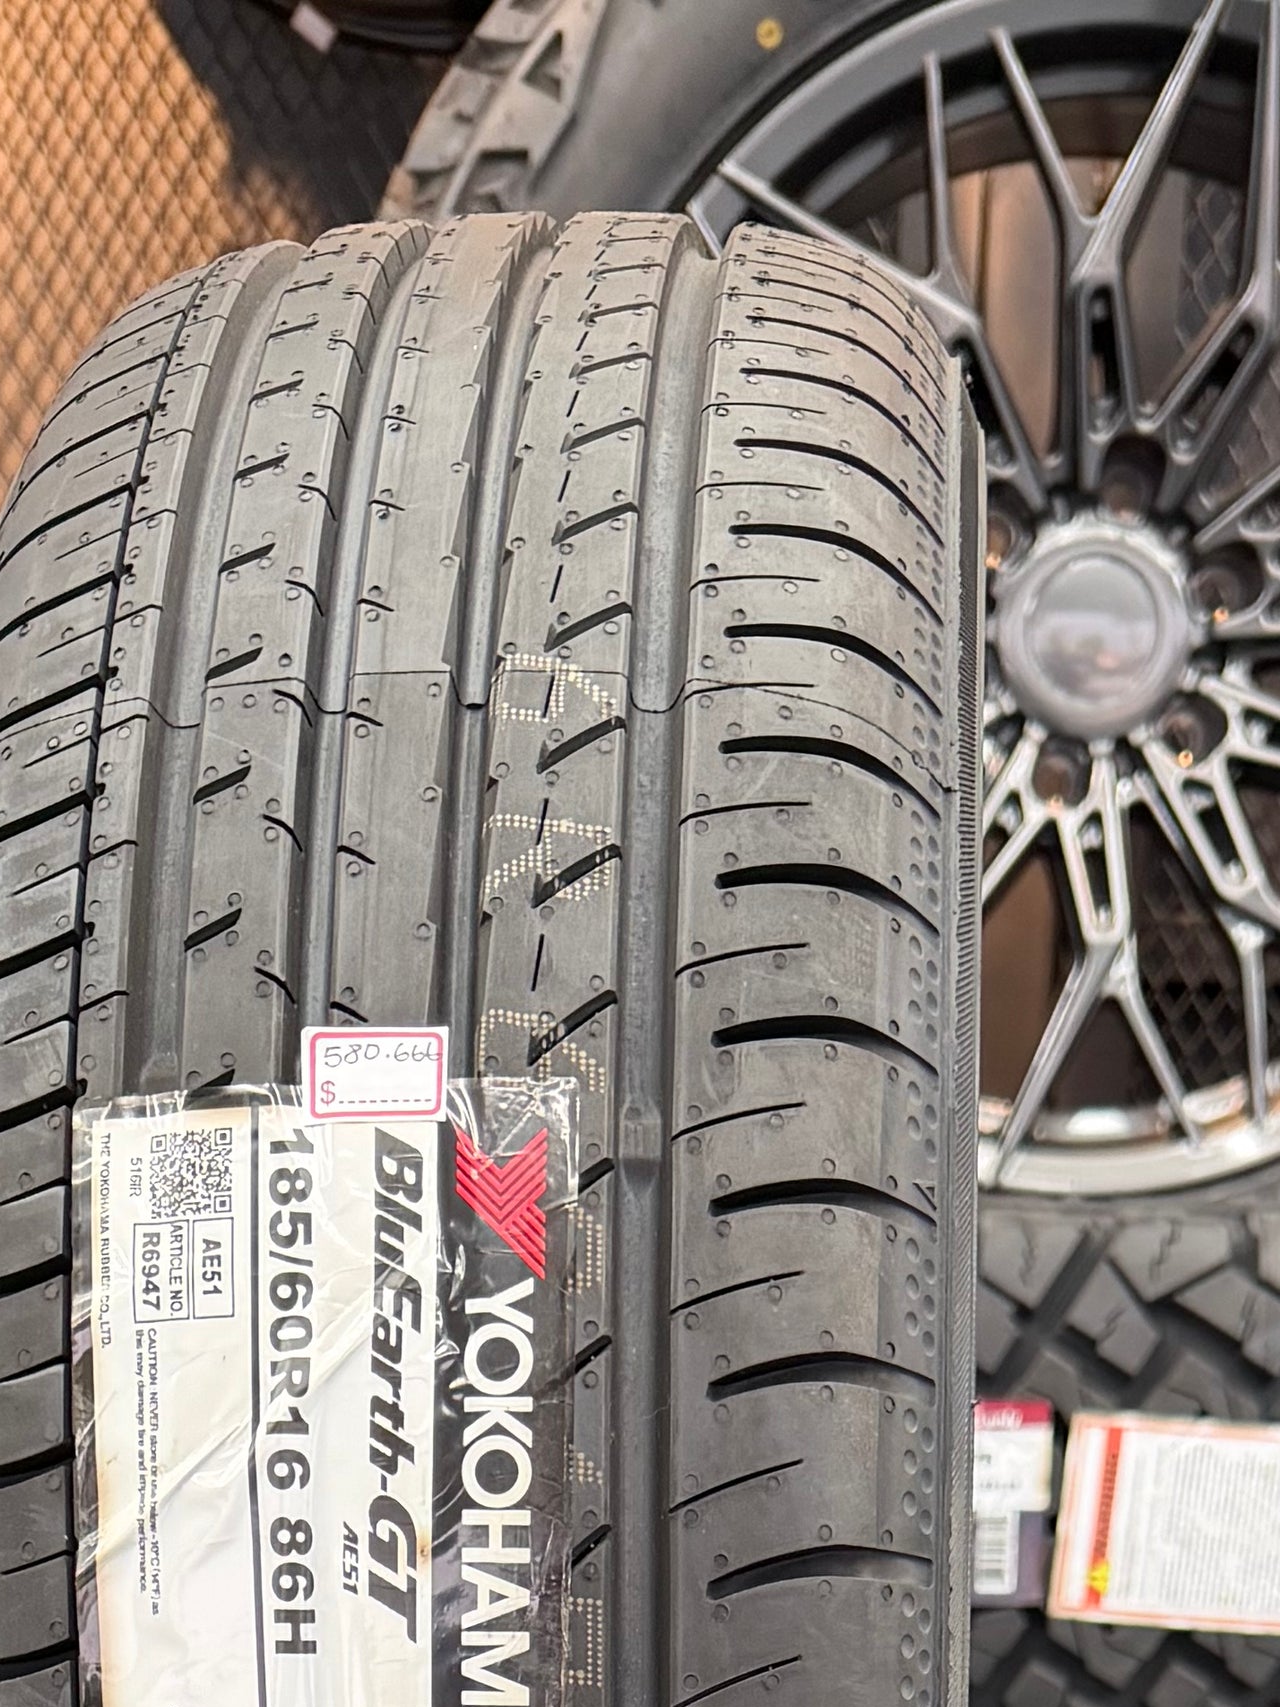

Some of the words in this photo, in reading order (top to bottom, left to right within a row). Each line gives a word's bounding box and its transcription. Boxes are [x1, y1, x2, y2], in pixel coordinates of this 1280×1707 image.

[100, 1161, 111, 1234] YOKOHAMA
[142, 1232, 161, 1311] R6947
[170, 1224, 183, 1285] ARTICLE
[202, 1238, 222, 1295] AE51
[170, 1290, 183, 1316] NO.
[266, 1127, 318, 1490] 185/60R16
[136, 1381, 146, 1425] damage
[150, 1392, 158, 1431] NEVER
[368, 1127, 424, 1643] BluEarth-GT
[138, 1450, 147, 1471] and
[269, 1517, 318, 1656] 86H
[343, 1522, 359, 1595] AE51
